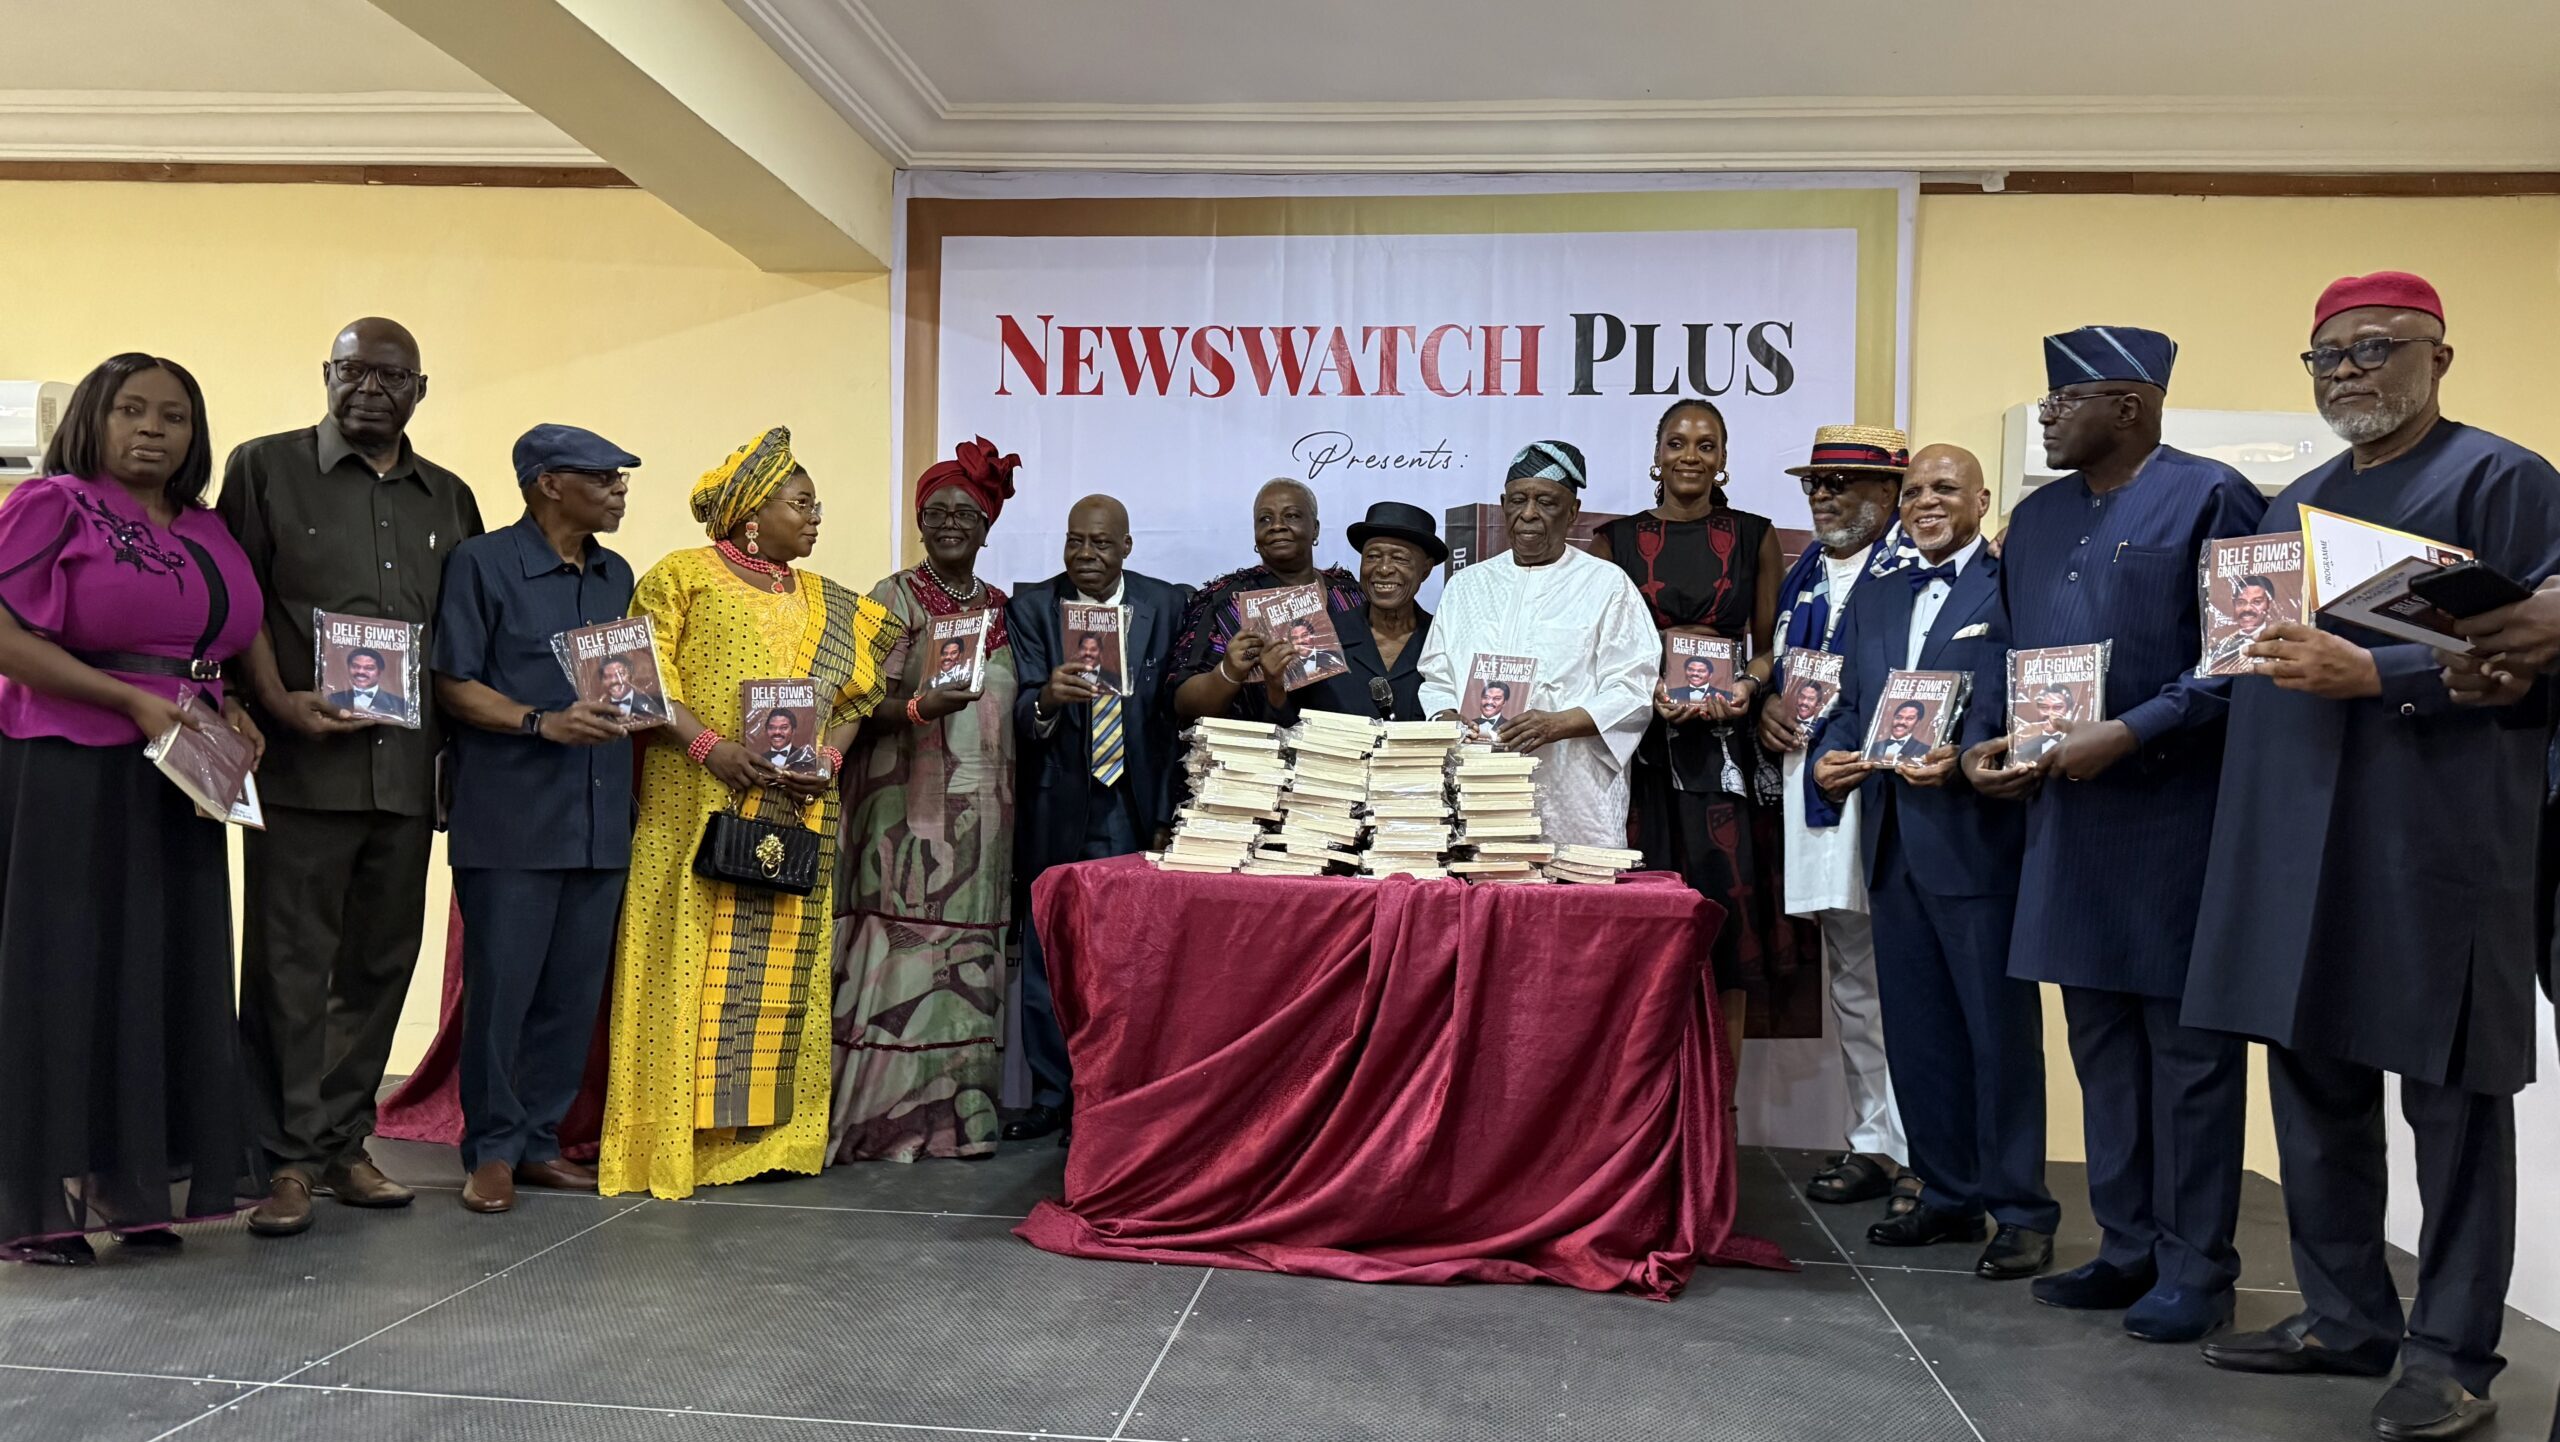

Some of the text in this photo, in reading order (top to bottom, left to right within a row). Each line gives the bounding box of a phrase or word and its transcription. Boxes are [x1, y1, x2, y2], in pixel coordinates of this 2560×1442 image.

[994, 312, 1795, 398] NEWSWATCH PLUS
[1291, 430, 1468, 480] Presents:
[1453, 547, 1467, 574] DE
[2218, 541, 2301, 567] DELE GIWA'S
[2217, 559, 2301, 578] GRANITE JOURNALISM
[1266, 591, 1319, 619] DELE GIWA'S
[935, 616, 983, 633] DELE GIWA'S
[1068, 610, 1116, 625] DELE GIWA'S
[332, 622, 406, 642] DELE GIWA'S
[576, 624, 646, 651] DELE GIWA'S
[332, 635, 406, 651] GRANITE JOURNALISM
[579, 638, 649, 660] GRANITE JOURNALISM
[1673, 637, 1730, 653] DELE GIWA'S
[1475, 660, 1533, 676] DELE GIWA'S
[2024, 655, 2094, 675] DELE GIWA'S
[1892, 679, 1952, 693] DELE GIWA'S
[2052, 671, 2094, 684] JOURNALISM
[751, 685, 814, 700] DELE GIWA'S
[751, 698, 814, 709] GRANITE JOURNALISM
